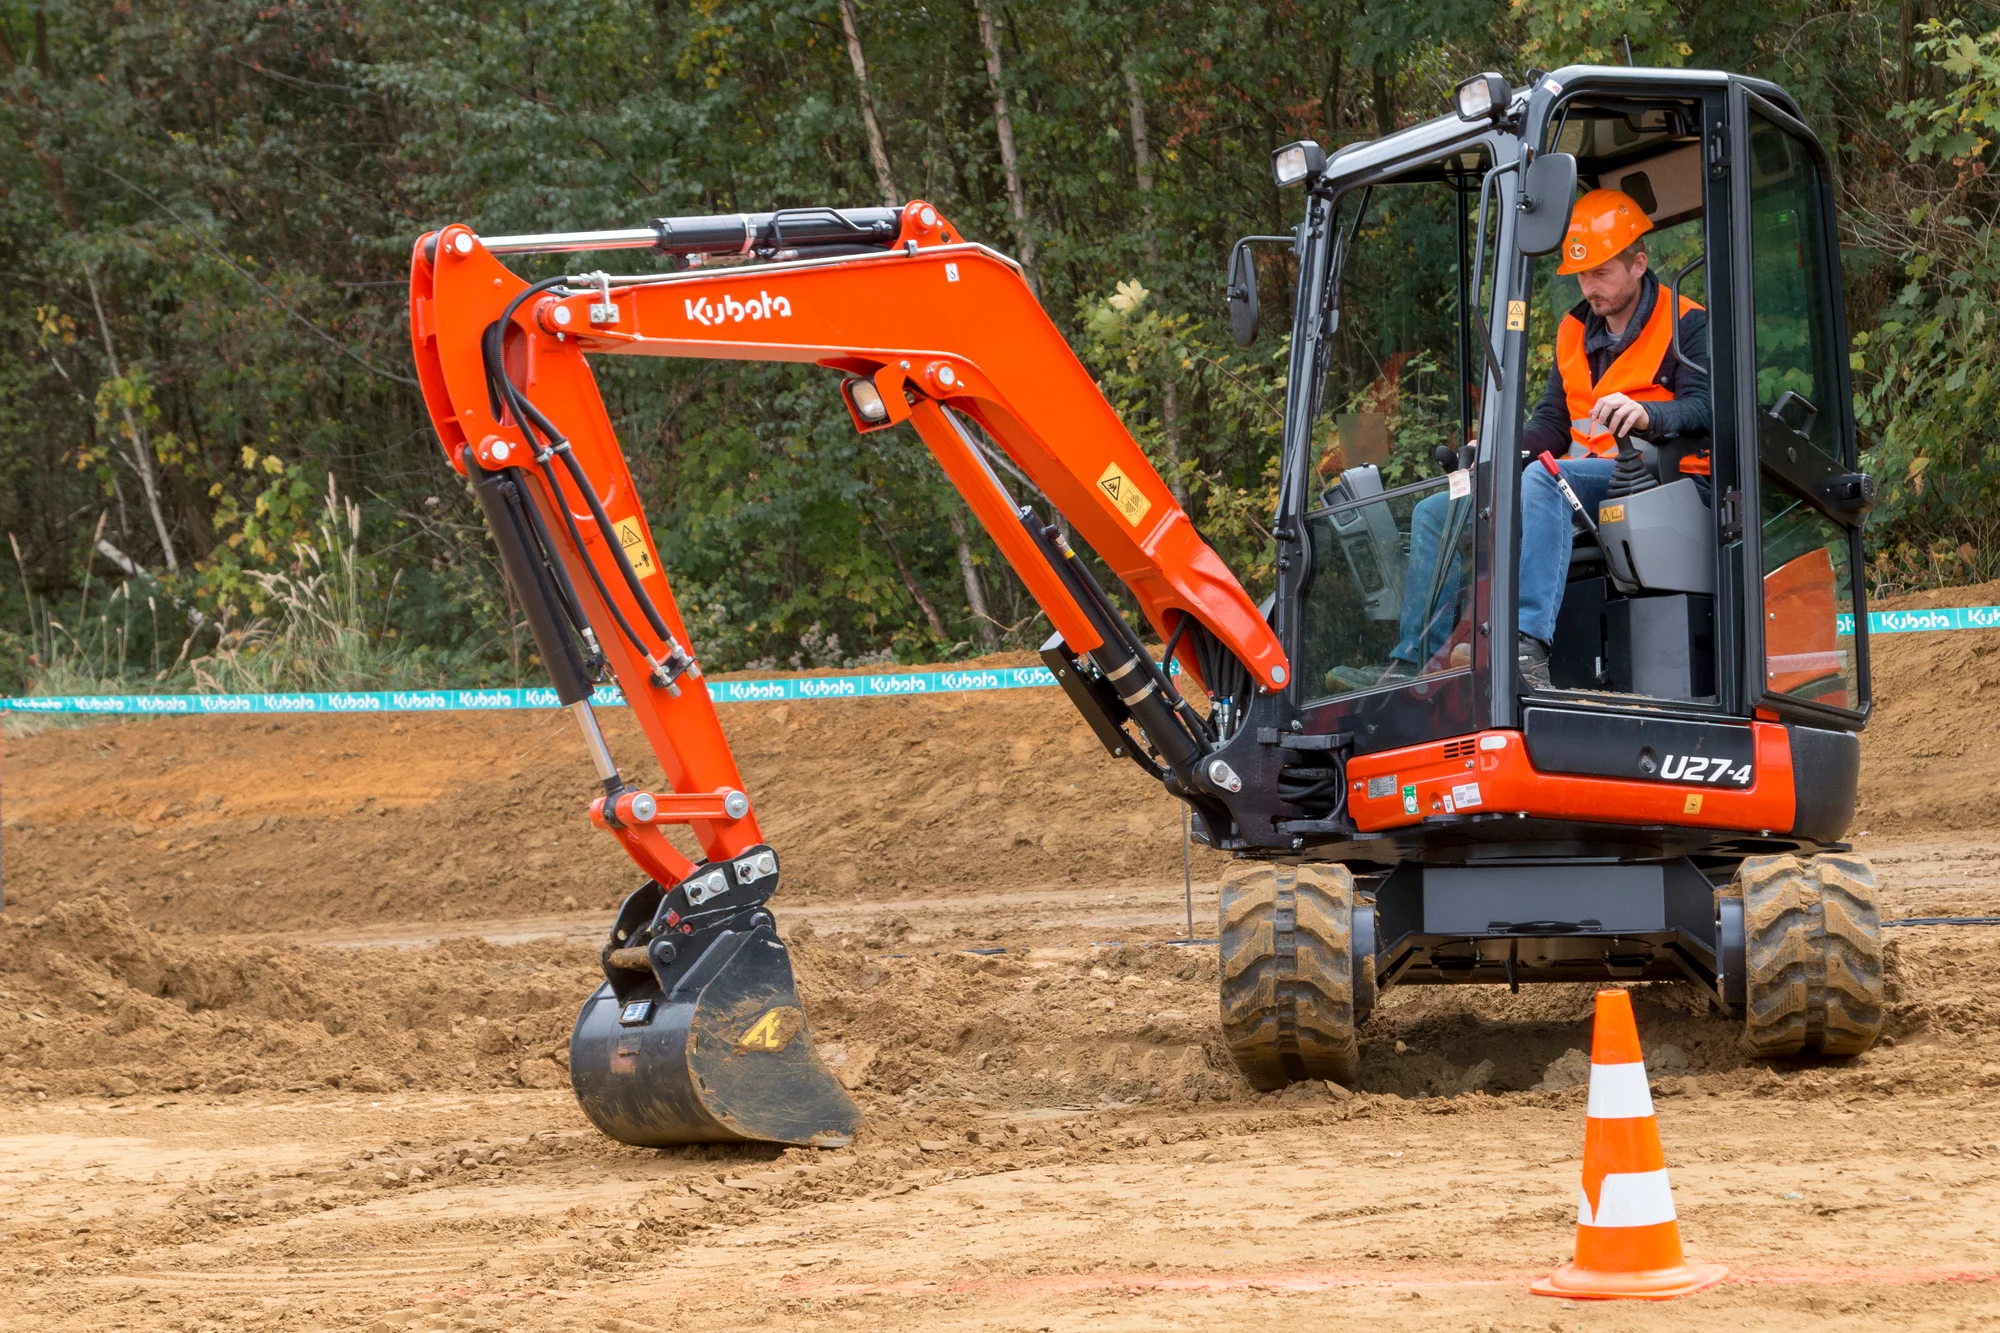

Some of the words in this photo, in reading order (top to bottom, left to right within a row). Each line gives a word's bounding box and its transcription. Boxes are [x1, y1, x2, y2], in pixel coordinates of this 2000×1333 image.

[685, 290, 792, 325] Kubota
[1881, 611, 1950, 630] Kubota
[1968, 609, 2000, 625] Kub
[74, 697, 124, 711] Kubota
[136, 697, 187, 711] Kubota
[199, 696, 251, 710] Kubota
[263, 695, 315, 709] Kubota
[328, 694, 380, 708] Kubota
[393, 693, 446, 708] Kubota
[459, 691, 512, 707] Kubota
[525, 690, 560, 706] Kub
[593, 688, 623, 704] Kub
[730, 682, 785, 699] Kubota
[799, 679, 855, 695] Kubota
[871, 676, 926, 692] Kubota
[1013, 669, 1057, 685] Kubo
[1660, 754, 1752, 784] U27-4
